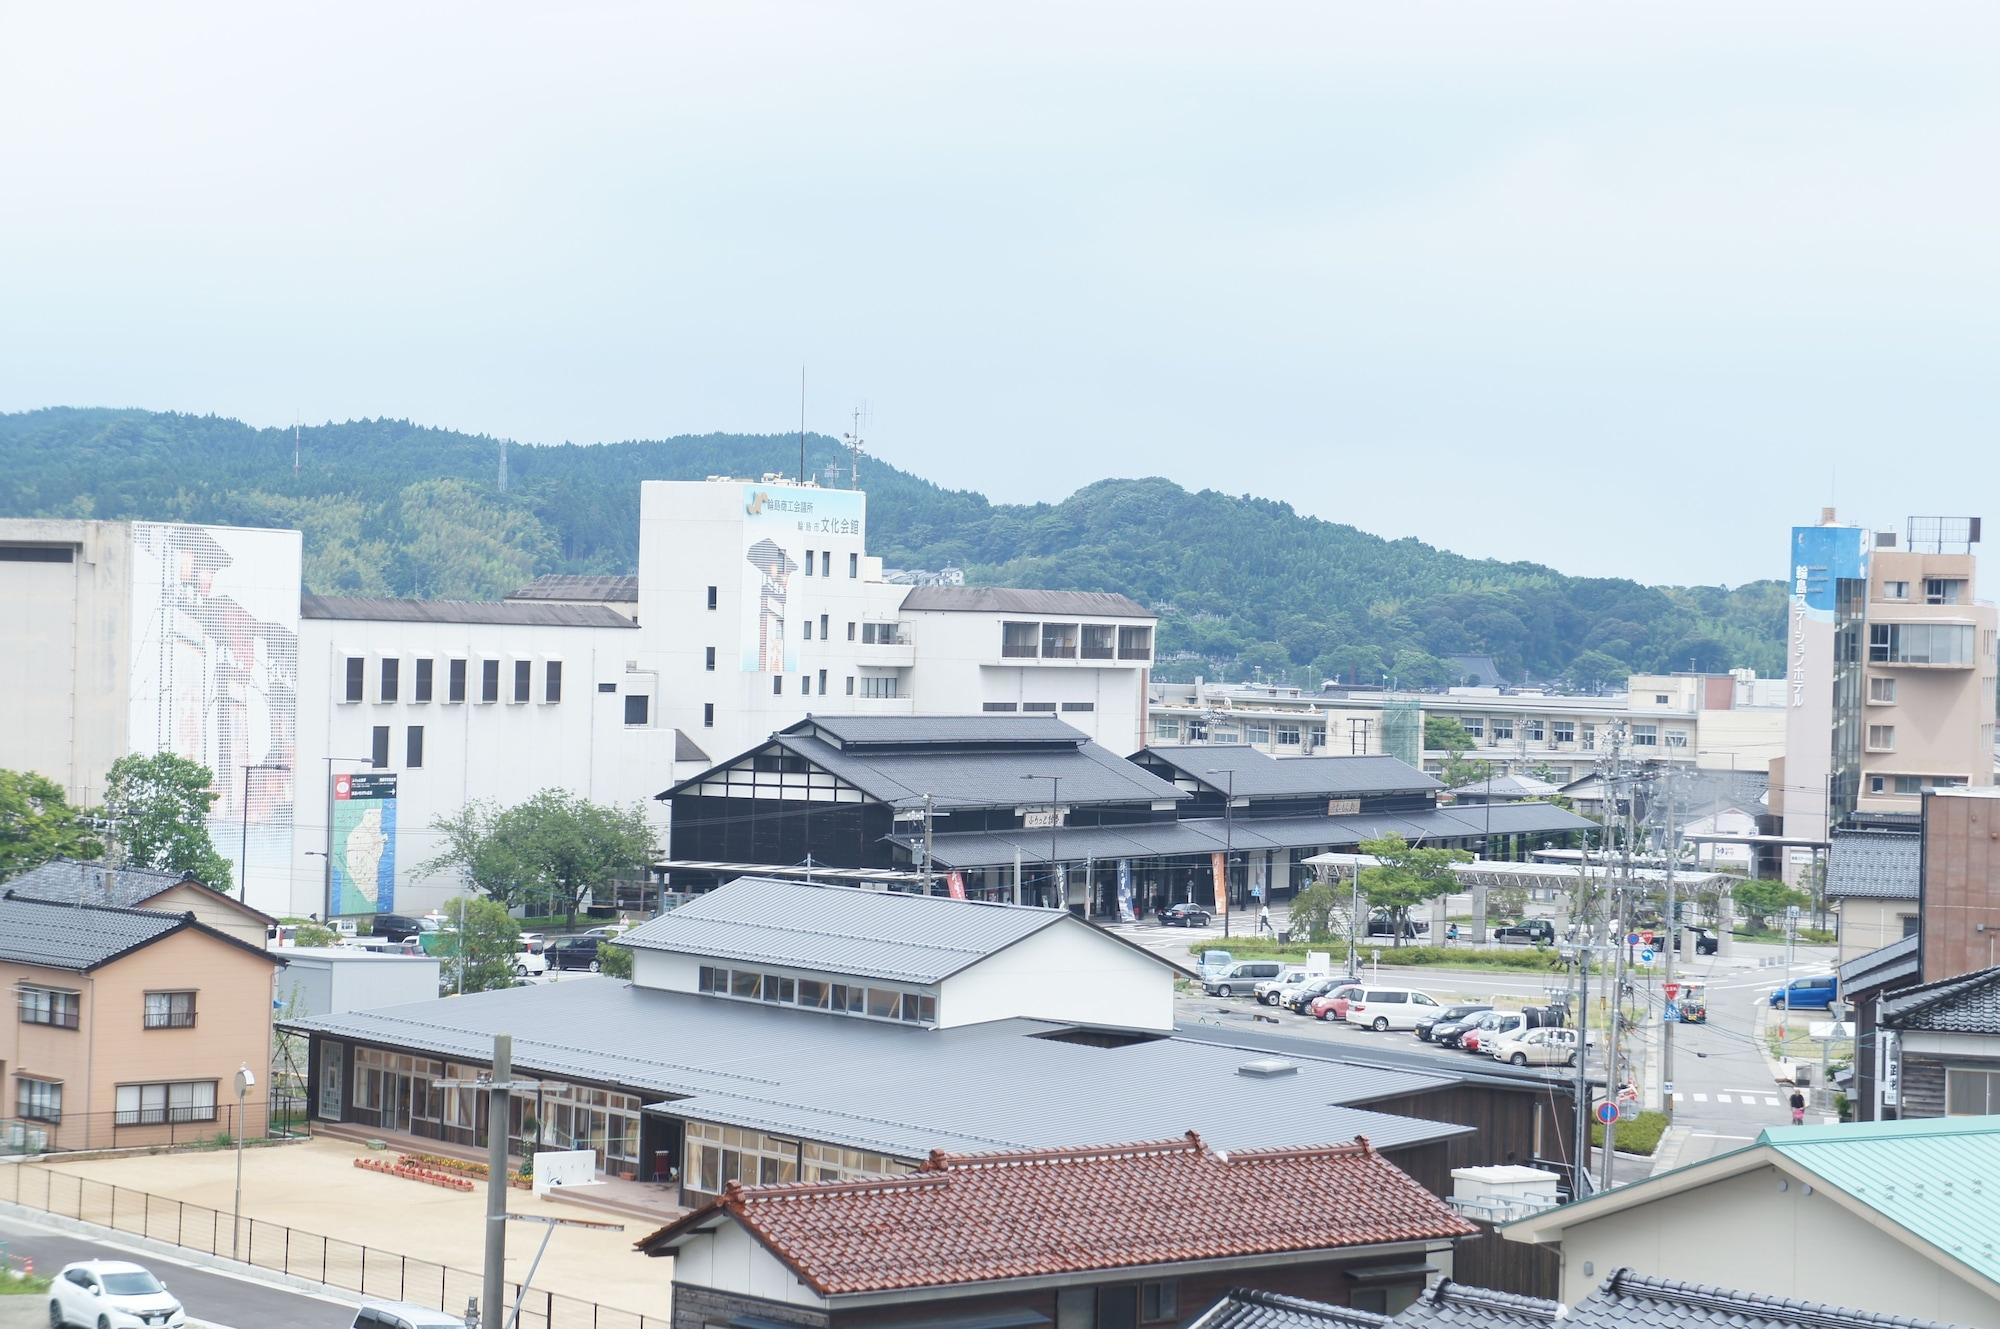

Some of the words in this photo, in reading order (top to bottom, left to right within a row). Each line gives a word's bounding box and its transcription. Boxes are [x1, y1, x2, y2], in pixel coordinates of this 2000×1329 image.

[1793, 565, 1808, 707] 輪島ステーションホテル
